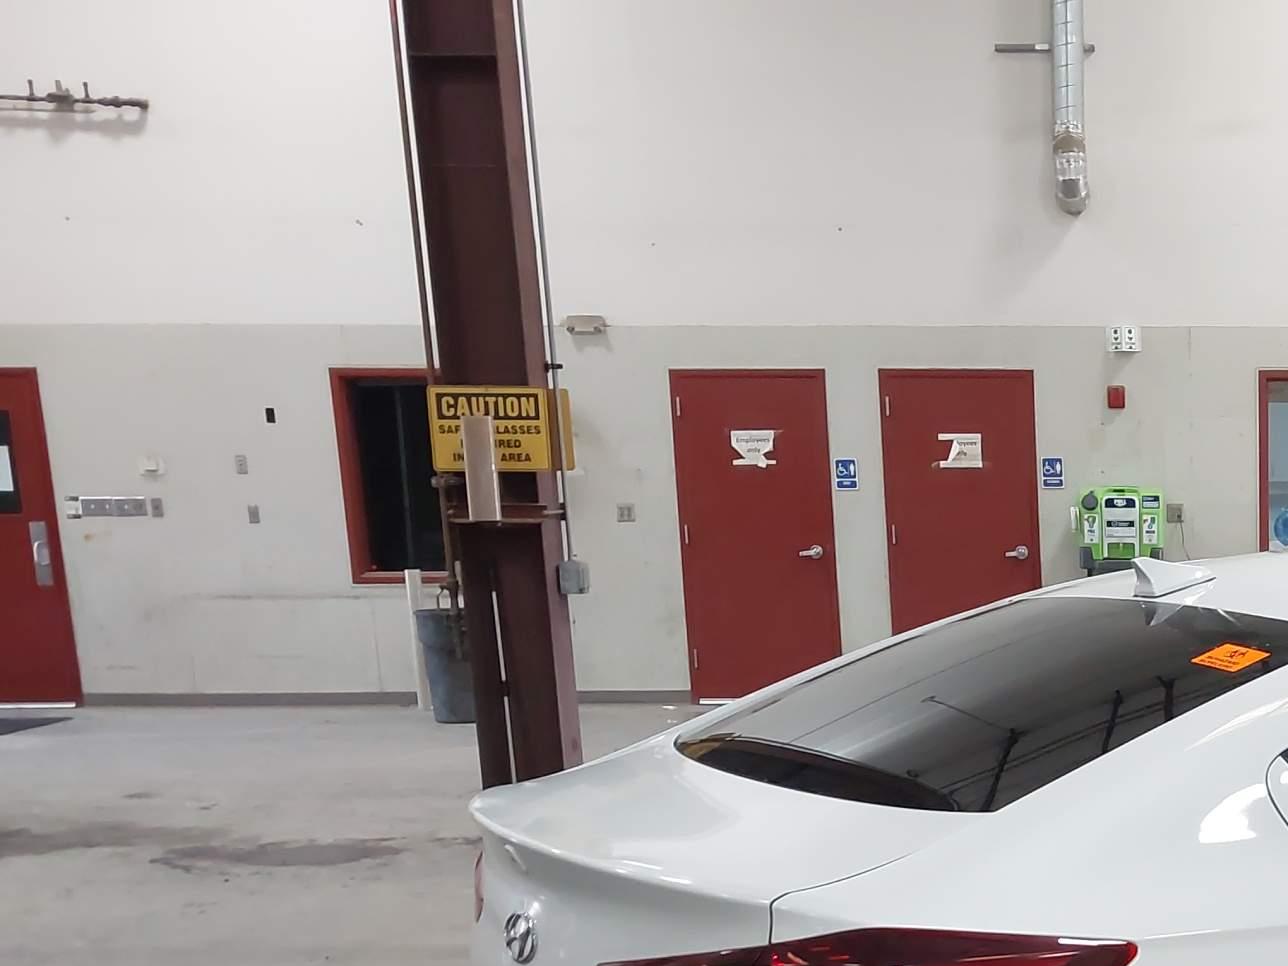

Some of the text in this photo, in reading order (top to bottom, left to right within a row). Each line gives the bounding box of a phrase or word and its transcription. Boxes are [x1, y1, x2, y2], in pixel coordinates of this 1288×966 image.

[440, 396, 536, 417] CAUTION
[495, 425, 541, 435] LASSES
[500, 452, 532, 462] AREA
